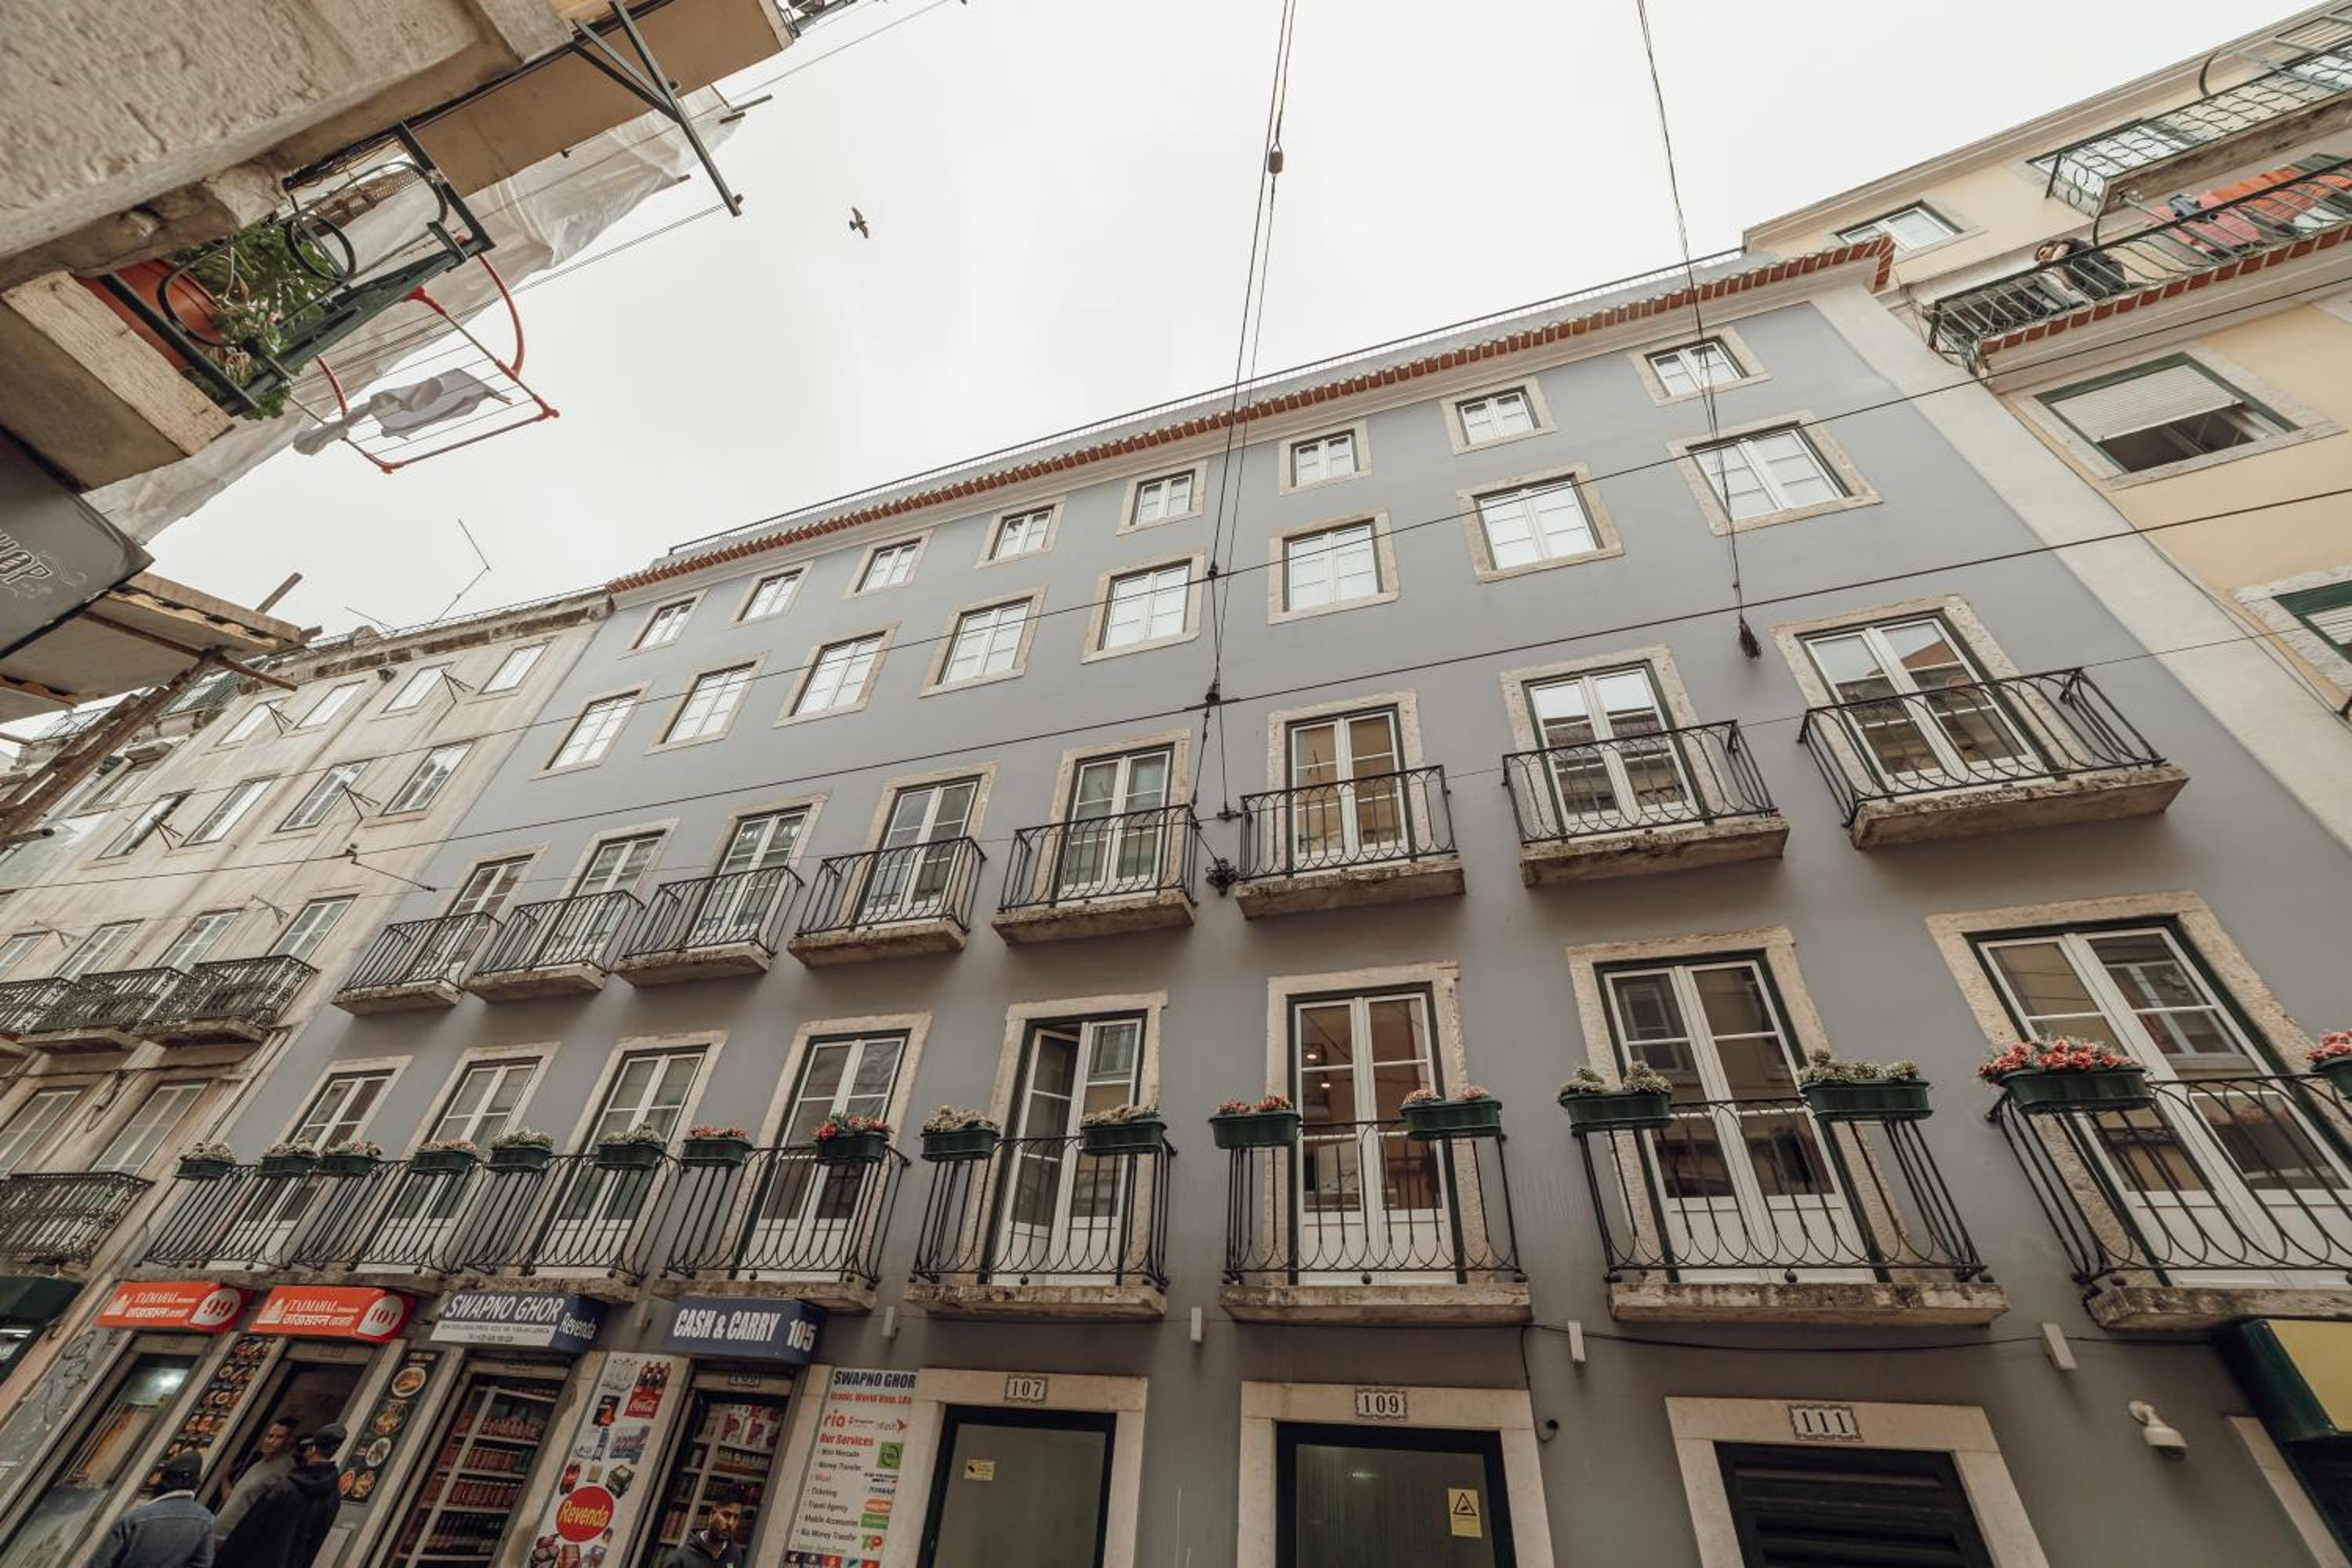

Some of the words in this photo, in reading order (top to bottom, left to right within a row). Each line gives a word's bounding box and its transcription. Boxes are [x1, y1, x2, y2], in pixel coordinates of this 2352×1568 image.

[203, 1298, 233, 1318] 99
[371, 1308, 396, 1326] 101
[445, 1294, 517, 1320] SWAPNO
[514, 1296, 565, 1323] GHOR
[673, 1308, 717, 1338] CASH
[713, 1315, 726, 1339] &
[726, 1310, 782, 1341] CARRY
[786, 1319, 817, 1352] 105
[833, 1370, 881, 1387] SWAPNO
[884, 1372, 916, 1388] GHOR
[1012, 1380, 1042, 1398] 107
[1363, 1394, 1399, 1414] 109
[1802, 1411, 1849, 1433] 111
[837, 1434, 874, 1446] Services
[558, 1499, 610, 1528] Revenda
